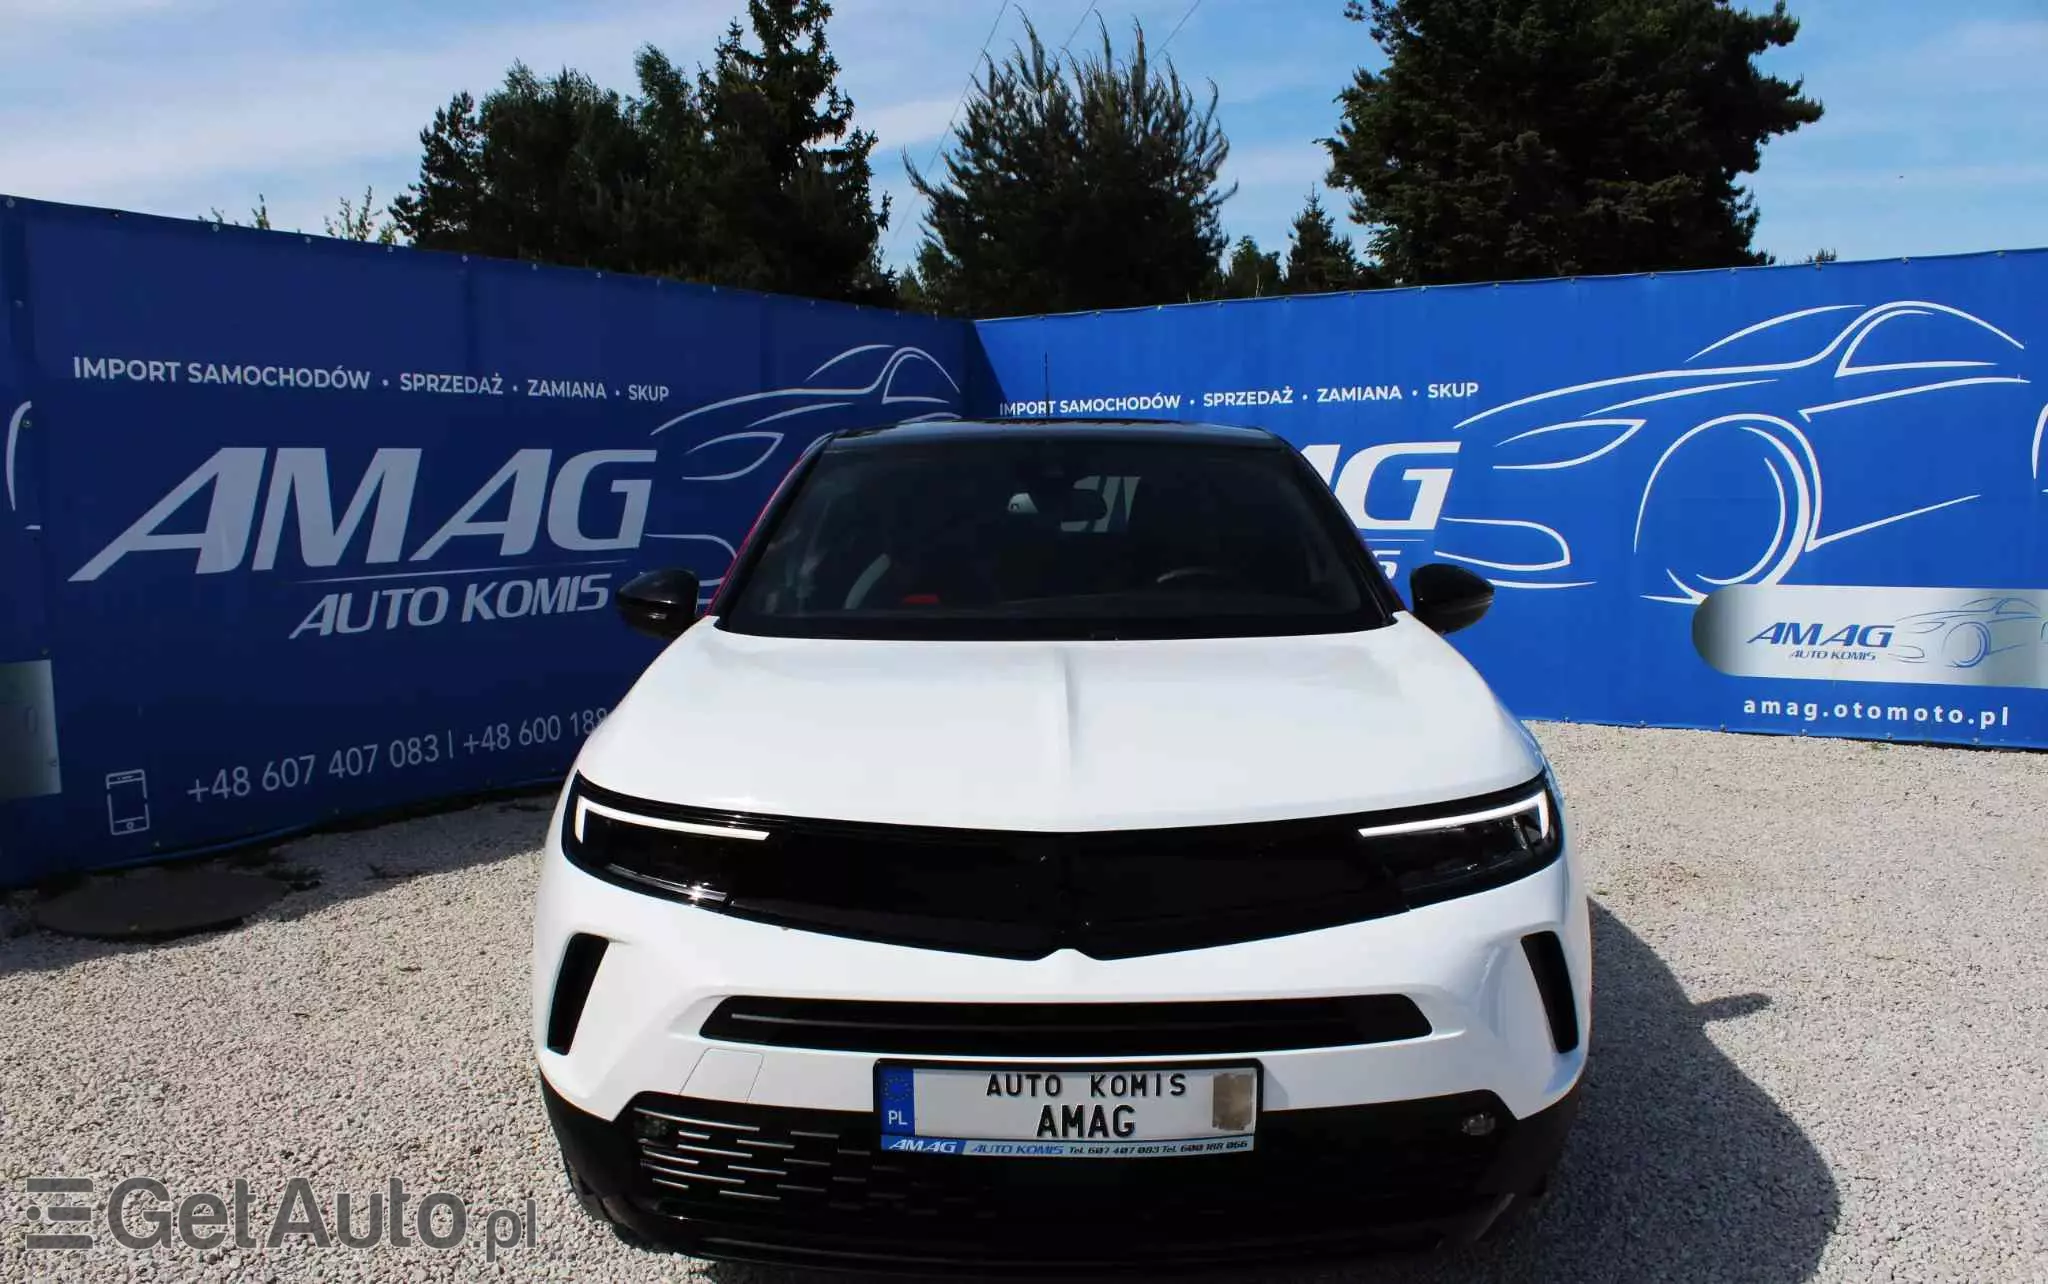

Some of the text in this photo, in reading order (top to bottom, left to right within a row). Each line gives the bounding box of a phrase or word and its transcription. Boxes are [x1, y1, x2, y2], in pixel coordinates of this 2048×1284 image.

[73, 356, 669, 402] IMPORT SAMOCHODÓW SPRZEDAŻ ZAMIANA SKUP
[1000, 382, 1479, 416] IMPORT SAMOCHODÓW SPRZEDAŻ ZAMIANA SKUP
[289, 574, 611, 639] AUTO KOMIS
[1790, 650, 1876, 661] AUTO KOMIS
[1743, 697, 2009, 729] amag.otomoto.pl
[187, 766, 250, 803] +48
[262, 755, 316, 793] 607
[329, 744, 378, 781] 407
[389, 735, 439, 769] 083
[464, 723, 511, 754] +48
[519, 715, 561, 745] 600
[986, 1073, 1187, 1097] AUTO KOMIS
[888, 1109, 908, 1126] PL
[1036, 1104, 1137, 1138] AMAG
[889, 1139, 957, 1153] AMAG
[973, 1144, 1012, 1154] AUTO
[1015, 1144, 1064, 1155] KOMIS
